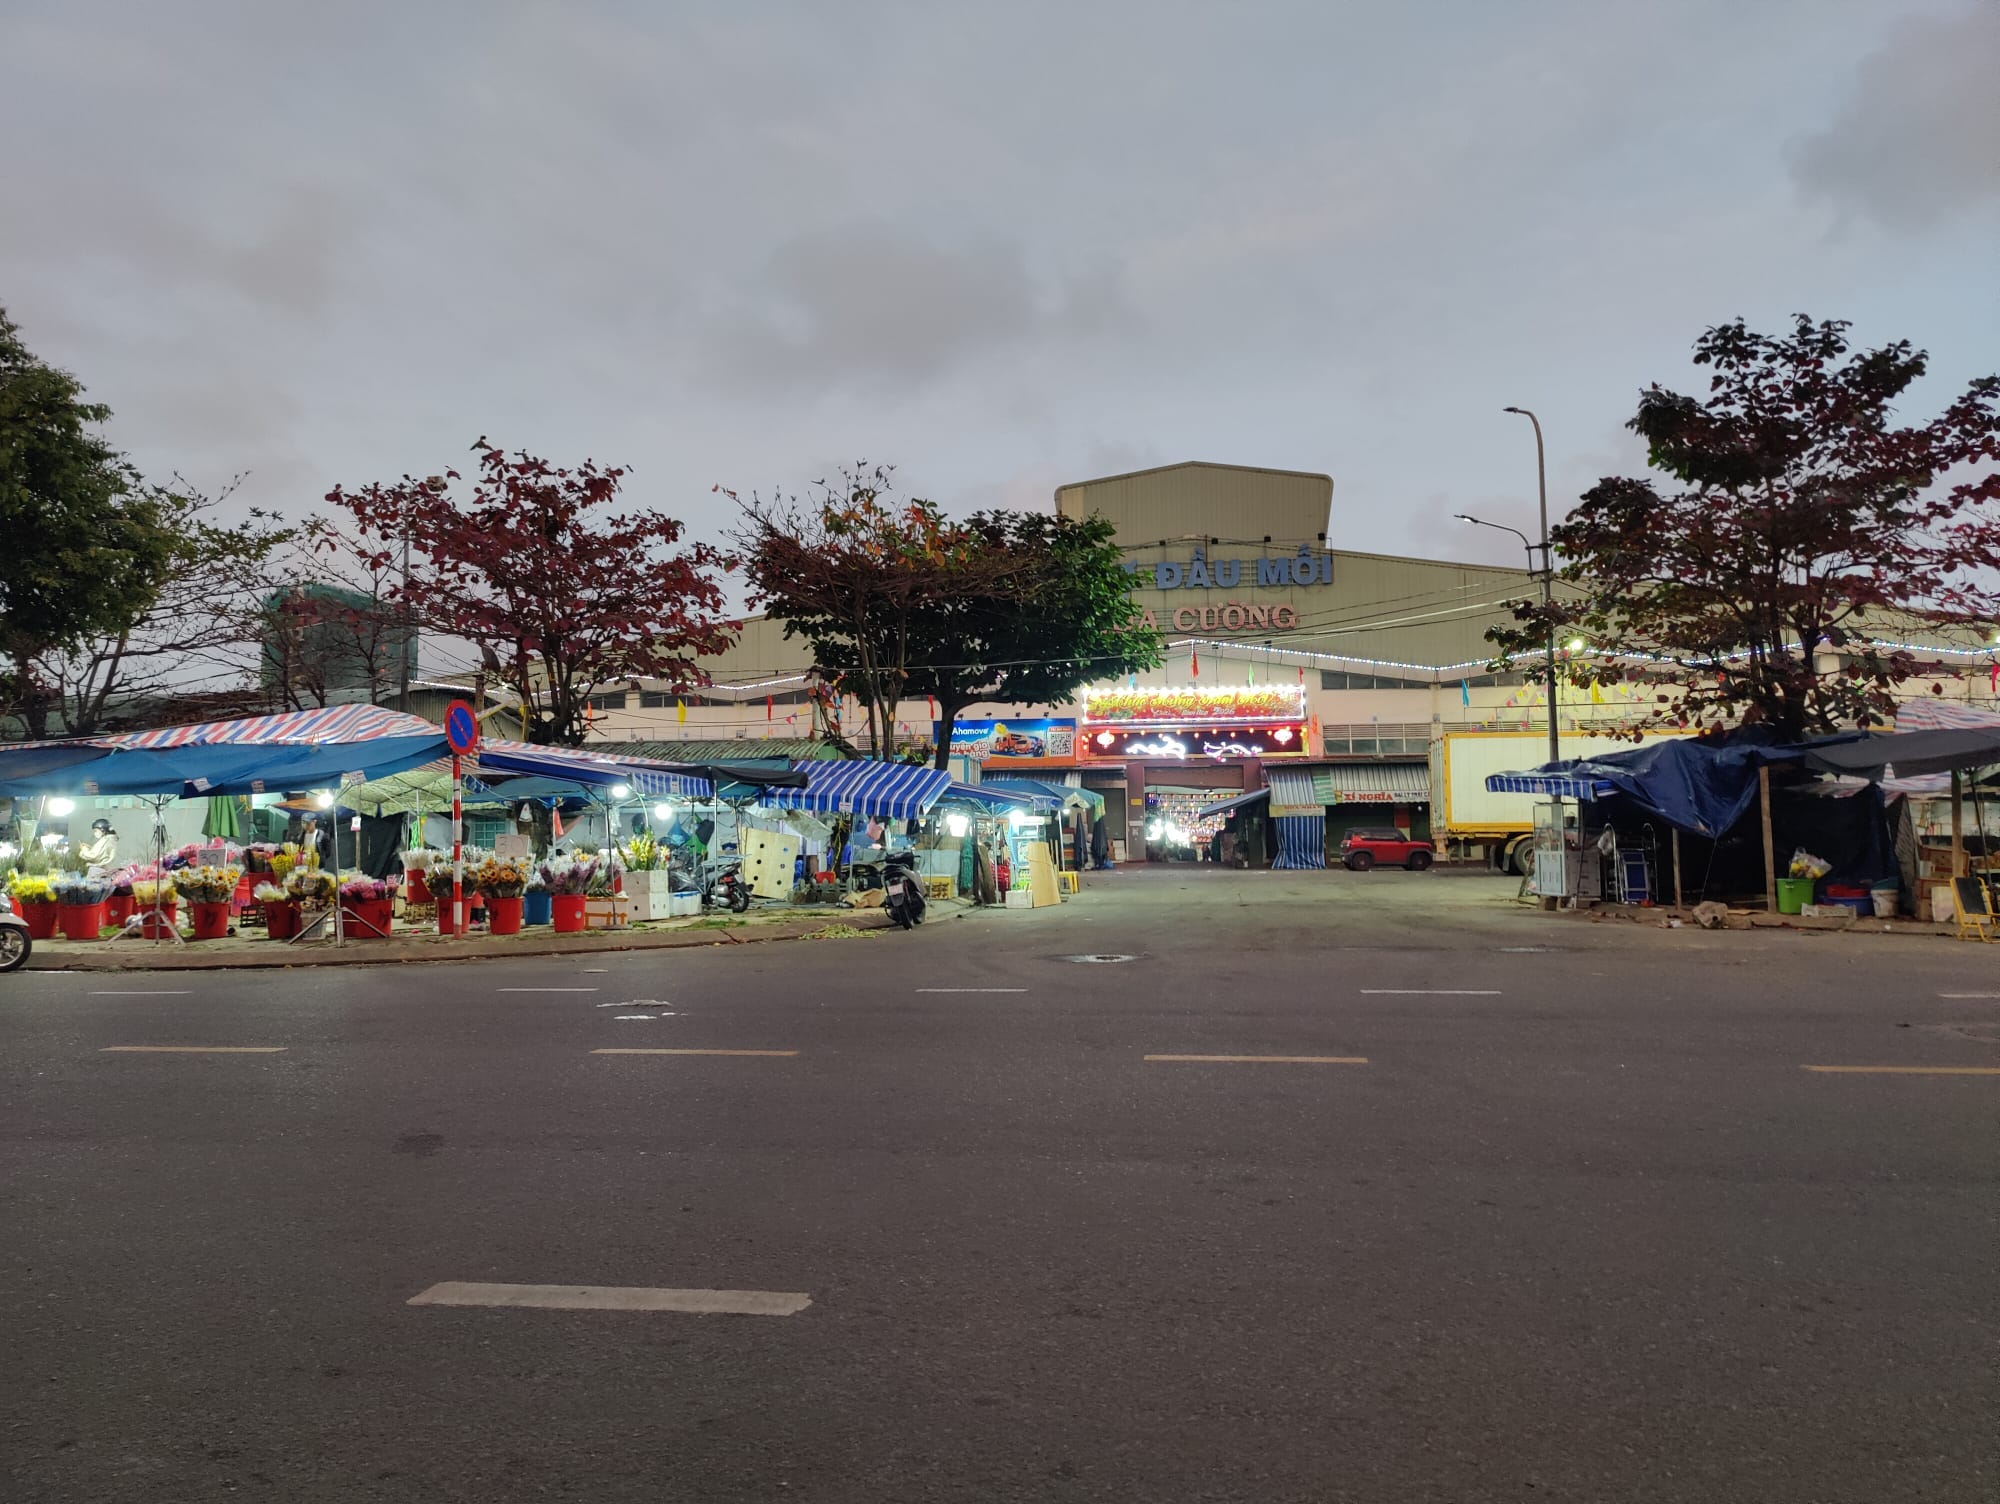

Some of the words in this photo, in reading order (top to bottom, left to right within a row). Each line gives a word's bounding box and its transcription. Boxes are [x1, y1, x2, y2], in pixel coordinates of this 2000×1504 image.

[1157, 548, 1240, 589] ĐẦU
[1257, 544, 1334, 586] MỐI
[1173, 599, 1297, 632] CƯỜNG
[952, 727, 989, 735] Ahamove
